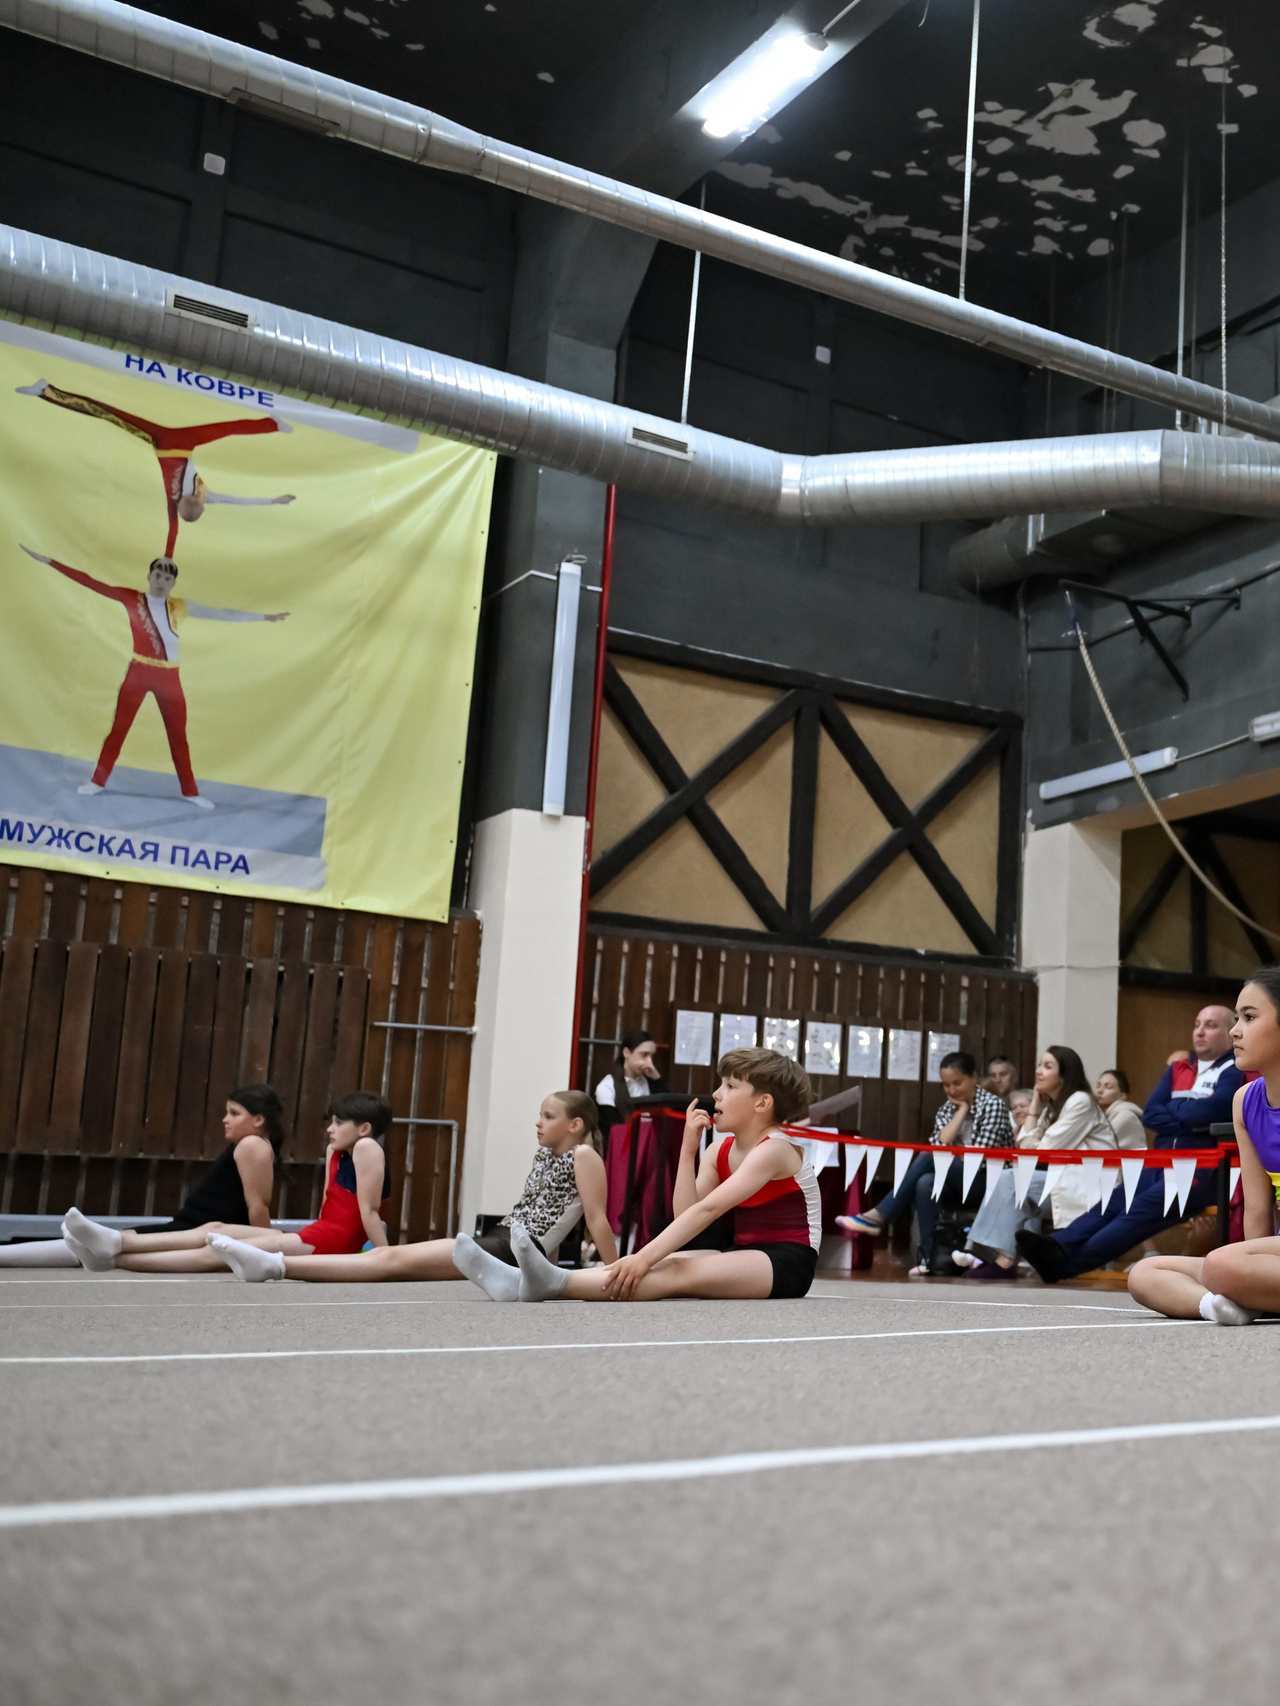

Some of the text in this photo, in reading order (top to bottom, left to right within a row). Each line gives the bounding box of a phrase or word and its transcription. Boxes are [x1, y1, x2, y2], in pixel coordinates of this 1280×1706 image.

[125, 354, 274, 408] НА КОВРЕ
[0, 818, 250, 875] МУЖСКАЯ ПАРА
